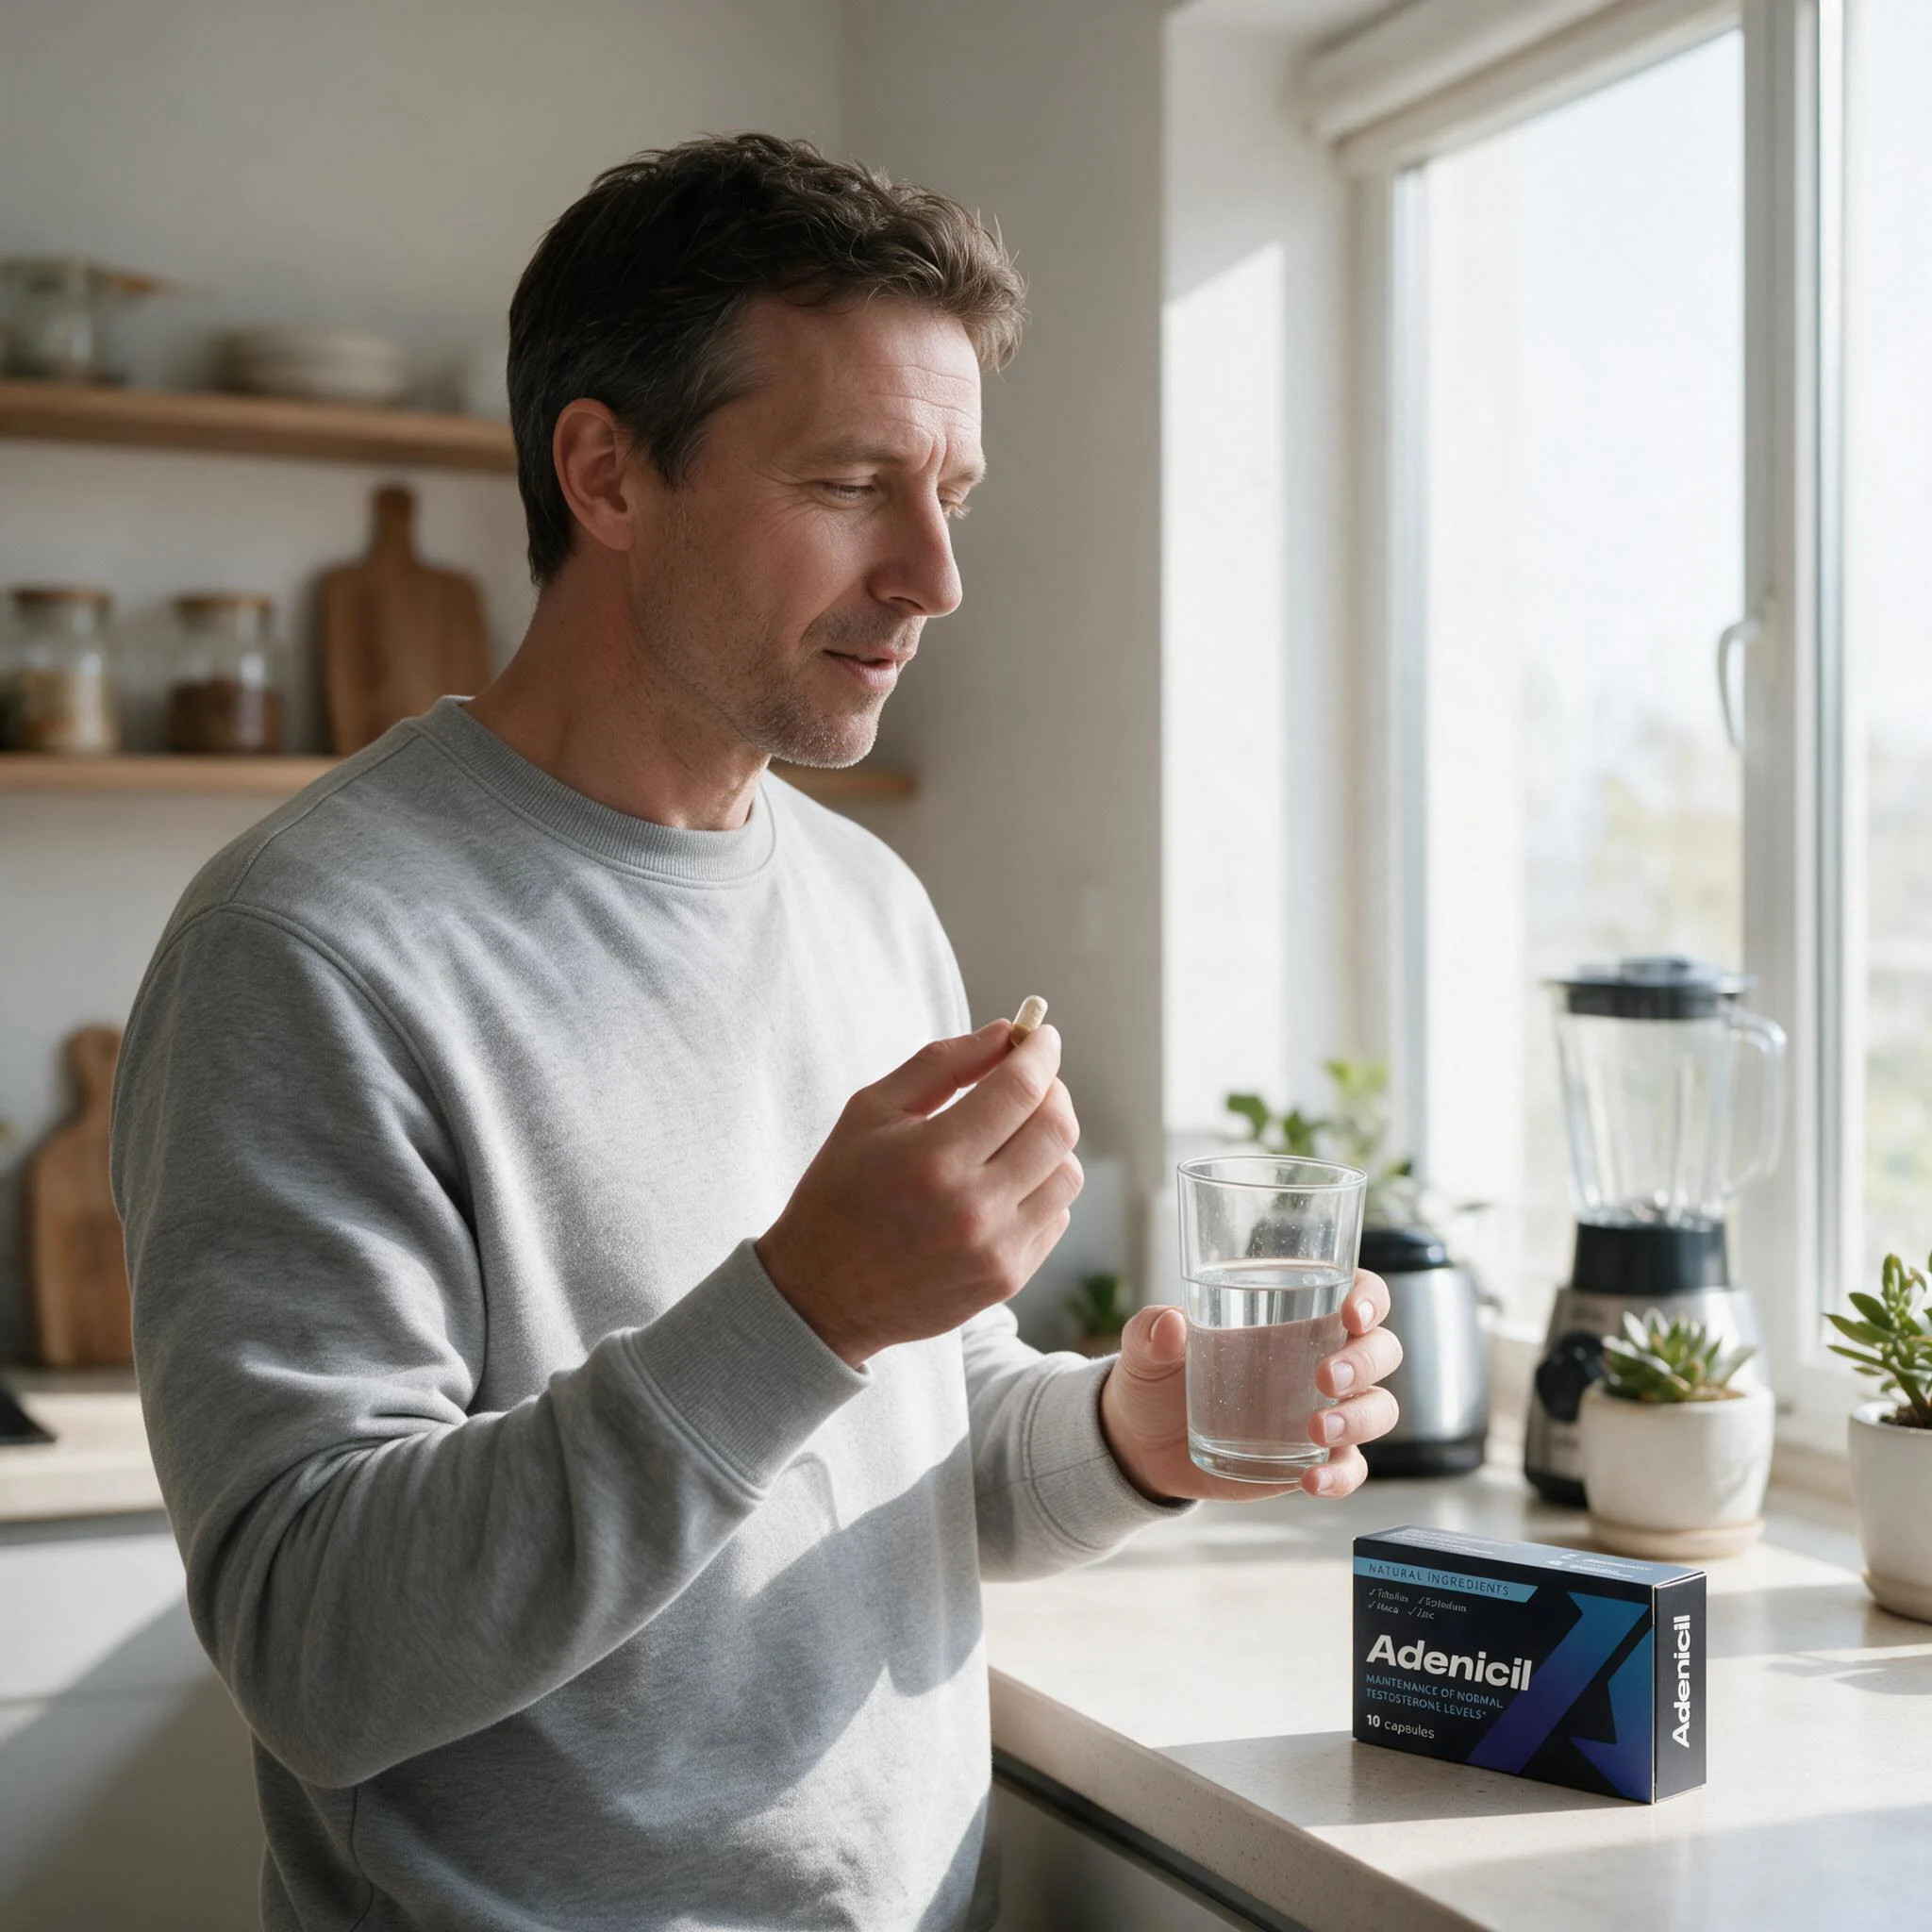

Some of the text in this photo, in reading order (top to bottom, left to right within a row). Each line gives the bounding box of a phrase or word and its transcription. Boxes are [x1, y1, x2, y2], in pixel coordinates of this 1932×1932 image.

[1369, 1563, 1509, 1596] NATURAL INGREDIENTS
[1366, 1634, 1533, 1691] Adenicil
[1367, 1674, 1504, 1708] MAINTENANCE OF NORMAL
[1672, 1614, 1691, 1749] Adenicil
[1367, 1688, 1441, 1712] TESTOSTERONE
[1367, 1714, 1435, 1739] 10 capsules
